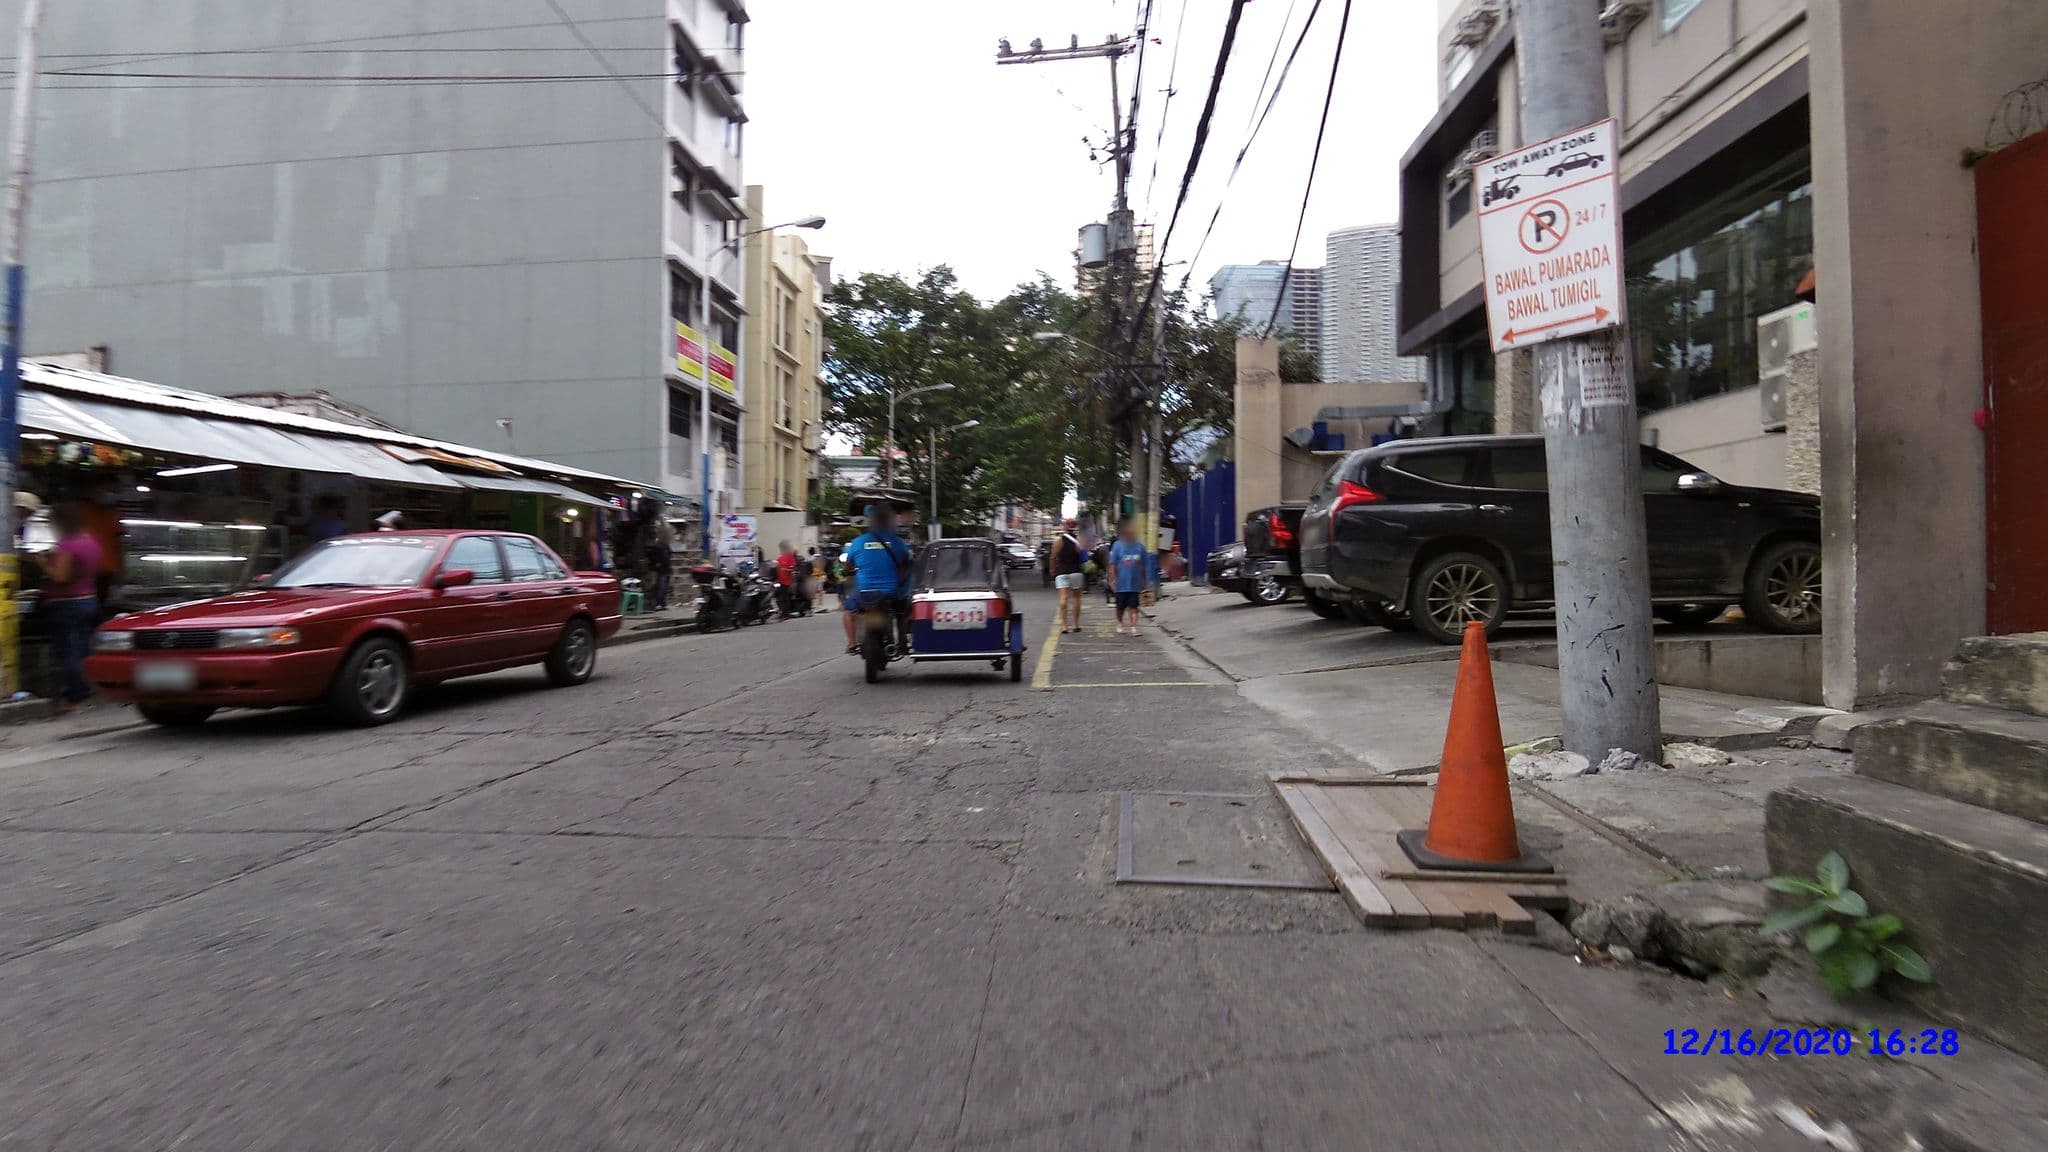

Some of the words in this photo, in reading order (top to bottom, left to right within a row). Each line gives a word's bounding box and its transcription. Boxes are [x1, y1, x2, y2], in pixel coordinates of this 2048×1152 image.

[1492, 158, 1518, 174] TOW
[1522, 145, 1557, 164] AWAY
[1561, 132, 1597, 151] ZONE
[1495, 266, 1536, 296] BAWAL
[1538, 244, 1610, 283] PUMARADA
[1507, 291, 1549, 320] BAWAL
[1551, 278, 1601, 310] TUMIGIL
